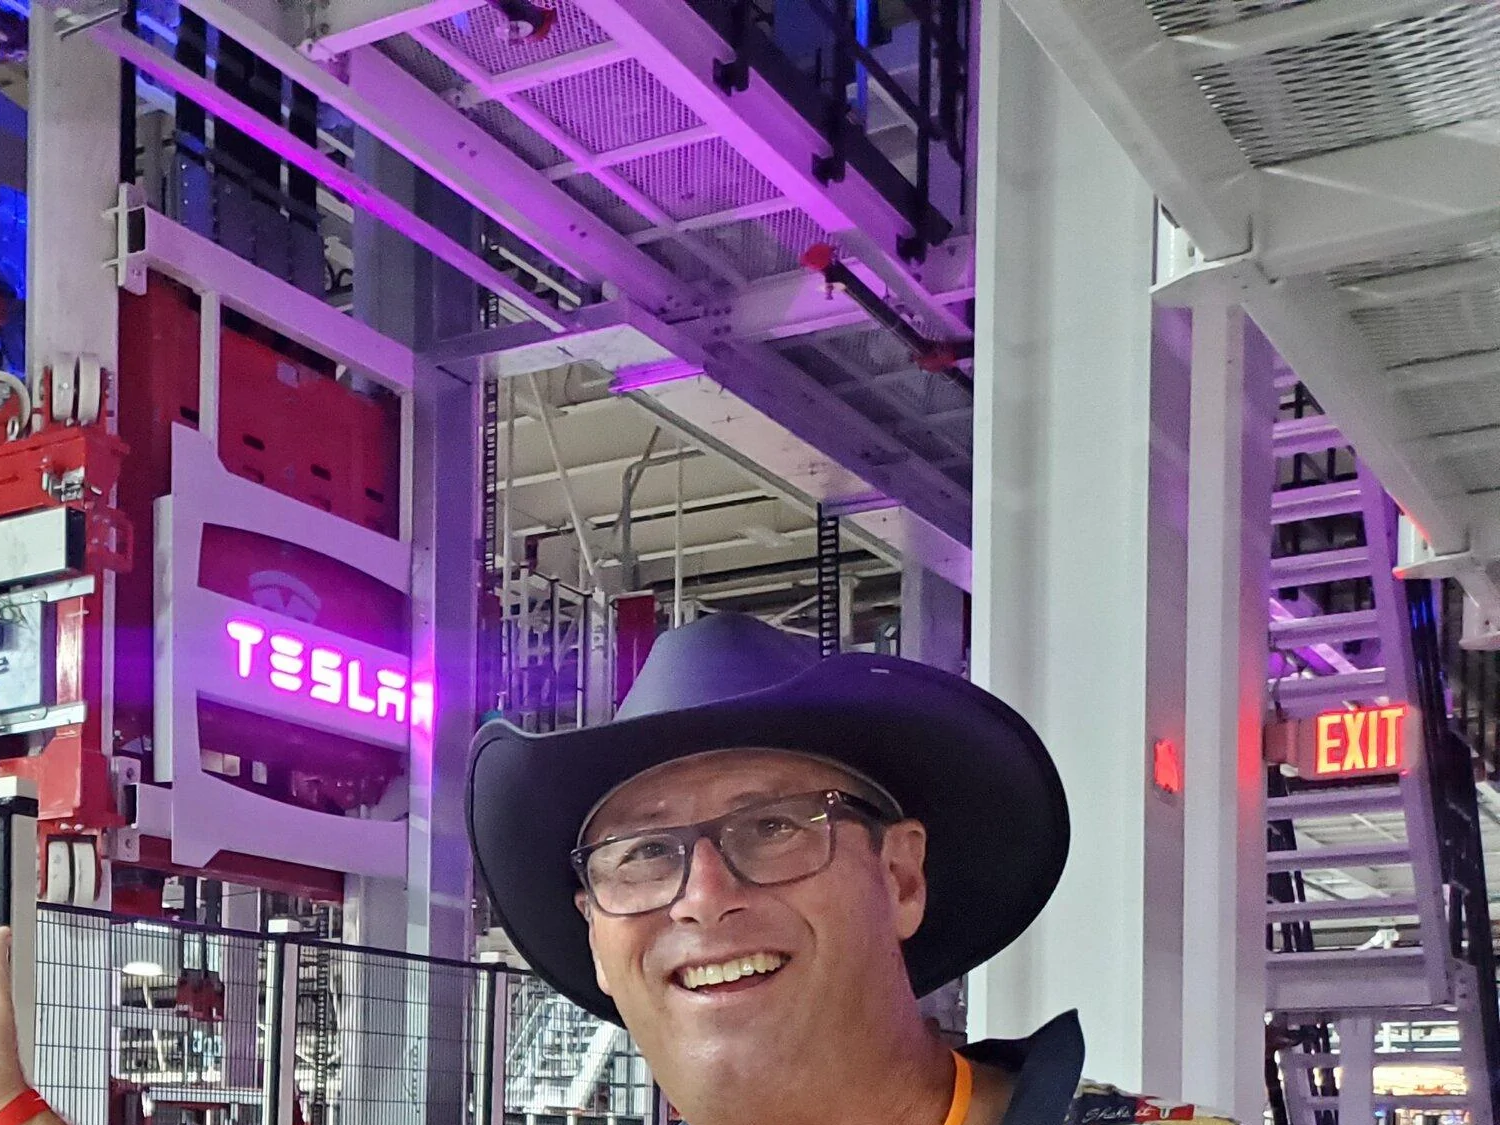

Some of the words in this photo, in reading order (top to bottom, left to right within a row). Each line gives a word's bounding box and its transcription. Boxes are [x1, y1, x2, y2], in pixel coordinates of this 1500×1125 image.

[226, 619, 407, 723] TESLA
[1316, 707, 1405, 774] EXIT
[1082, 1107, 1131, 1124] Shake
[1134, 1104, 1156, 1117] it
